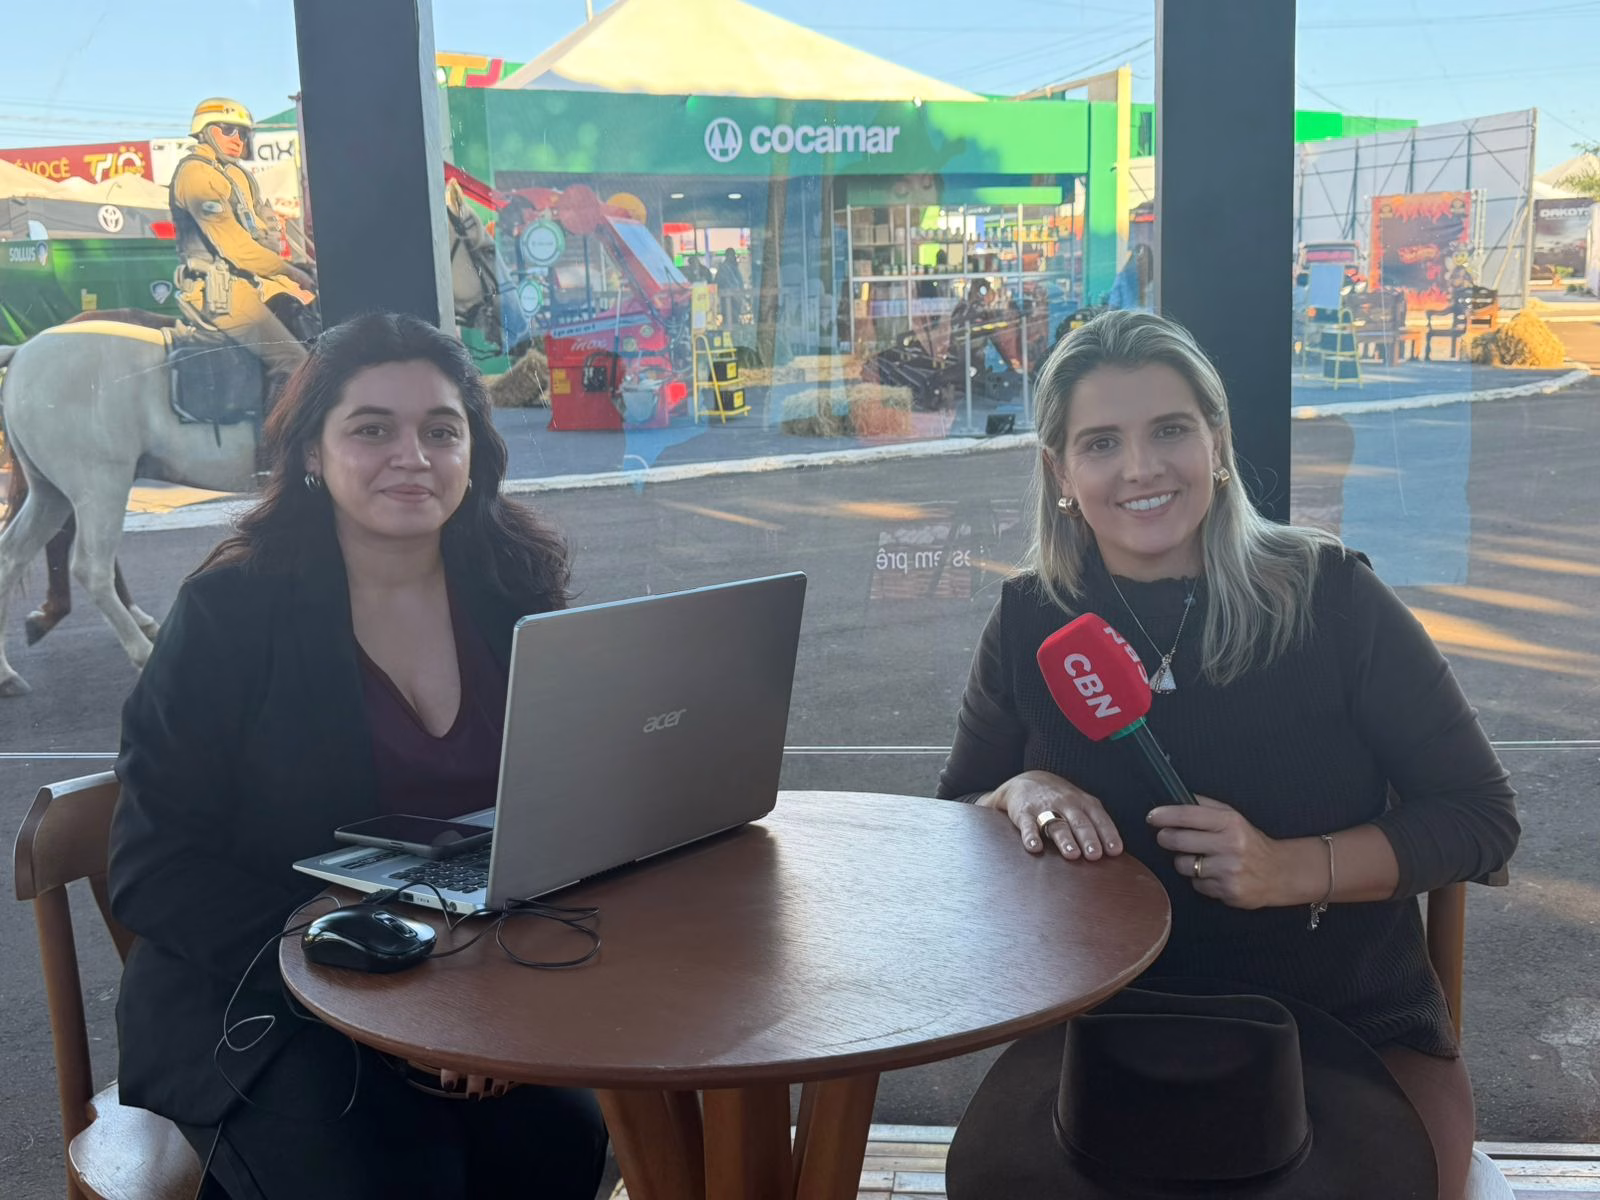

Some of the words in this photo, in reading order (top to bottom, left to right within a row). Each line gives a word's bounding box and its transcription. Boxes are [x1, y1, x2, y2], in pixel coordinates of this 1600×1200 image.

[749, 124, 901, 154] cocamar
[9, 246, 36, 262] SOLLUS
[1064, 653, 1122, 718] CBN
[643, 708, 687, 733] acer
